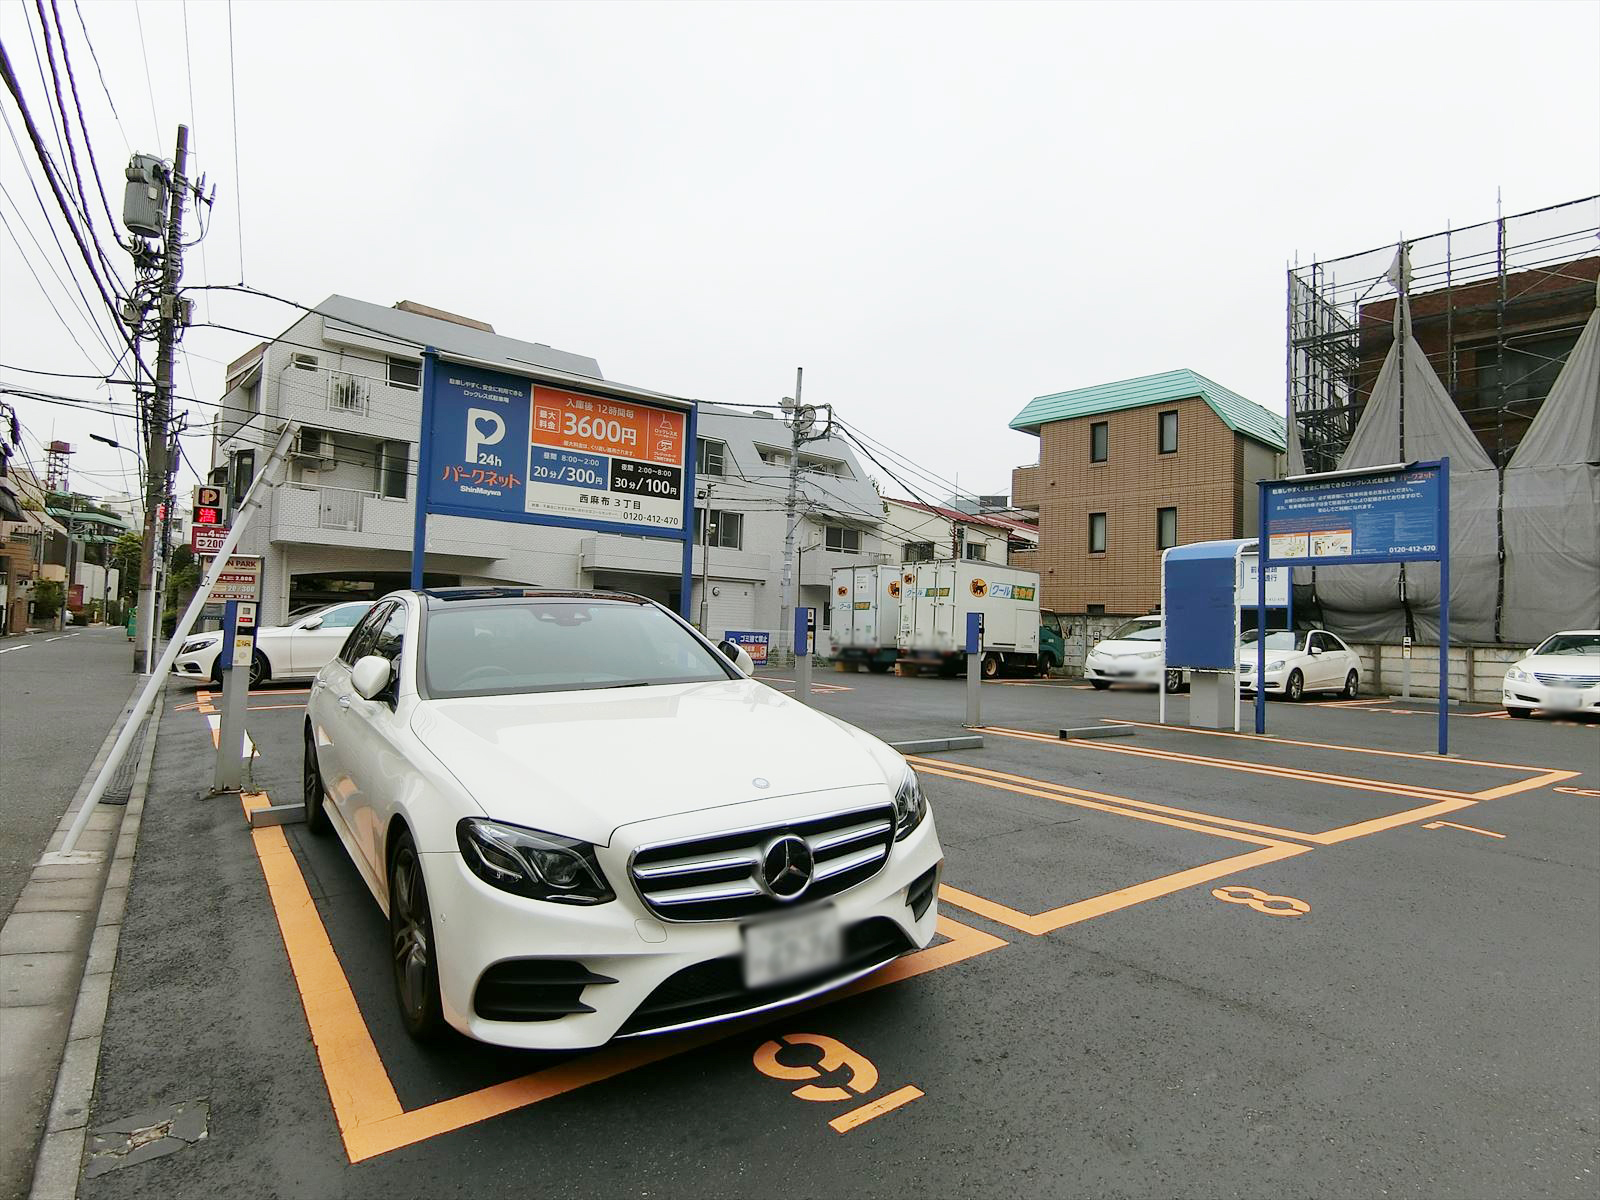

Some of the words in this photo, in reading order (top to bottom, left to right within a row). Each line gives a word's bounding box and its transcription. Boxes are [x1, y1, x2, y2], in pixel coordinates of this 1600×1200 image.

[539, 409, 556, 420] 最大
[566, 398, 593, 412] 入庫後
[597, 404, 634, 419] 12時間毎
[539, 420, 556, 430] 料金
[563, 412, 637, 446] 3600円
[465, 408, 506, 463] P
[478, 453, 502, 467] 24h
[543, 452, 557, 461] 昼間
[621, 463, 634, 472] 夜間
[442, 465, 521, 489] パークネット
[460, 485, 502, 496] ShinMaywa
[623, 511, 679, 526] 0120-412-470
[1388, 545, 1437, 554] 0120-412-470
[236, 560, 256, 568] PARK
[1211, 885, 1312, 917] 8
